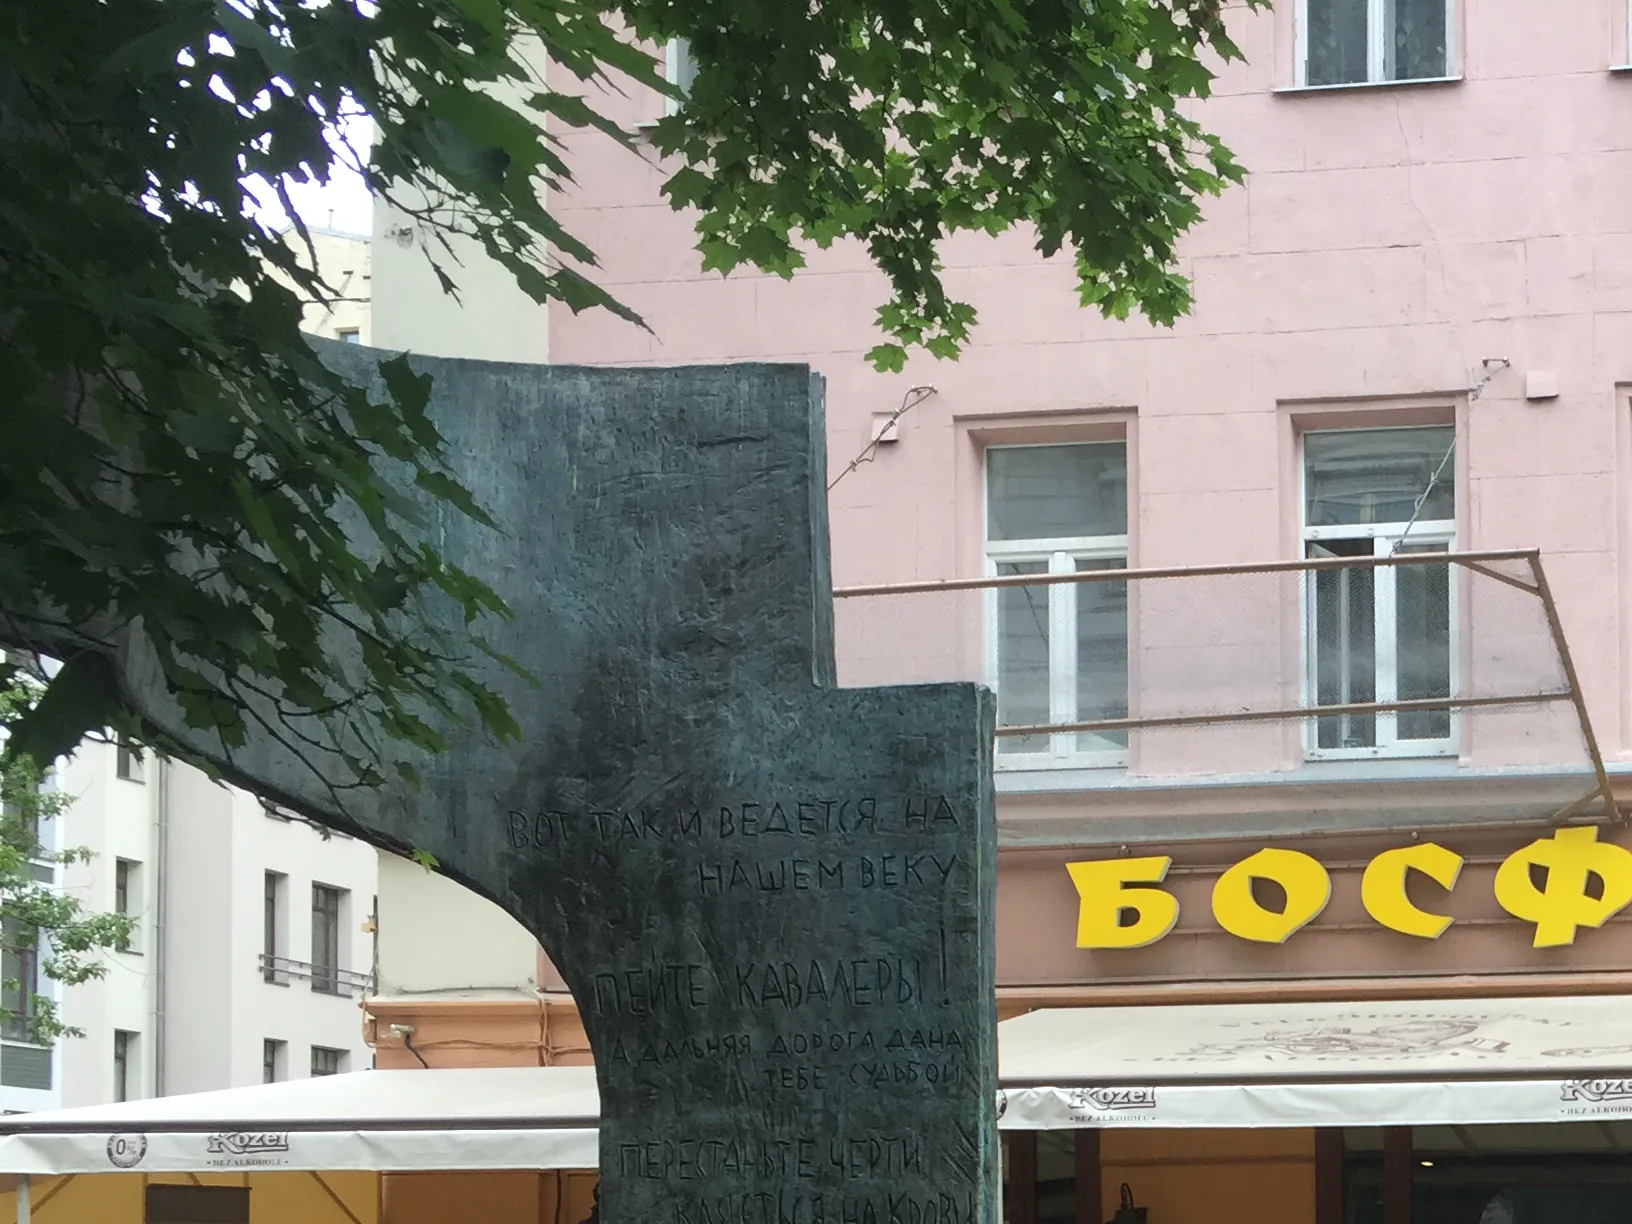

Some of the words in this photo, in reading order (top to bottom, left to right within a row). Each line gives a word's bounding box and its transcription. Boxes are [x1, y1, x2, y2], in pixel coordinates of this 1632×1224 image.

[507, 811, 571, 850] ВОТ
[589, 808, 661, 842] ТАК
[679, 810, 702, 839] И
[718, 799, 877, 840] ВЕДЕТСЯ
[905, 795, 959, 829] НА
[700, 858, 845, 896] НАШЕМ
[861, 853, 957, 890] ВЕКУ
[594, 949, 708, 1017] ПЕЙТЕ
[611, 1038, 632, 1064] А
[637, 1034, 752, 1067] ДАЛЬНЯЯ
[766, 1030, 877, 1060] ДОРОГА
[885, 1028, 963, 1052] ДАНА
[764, 1067, 827, 1092] ТЕБЕ
[849, 1054, 960, 1089] СУДЬБОЙ
[830, 1136, 922, 1180] ЧЕРТИ
